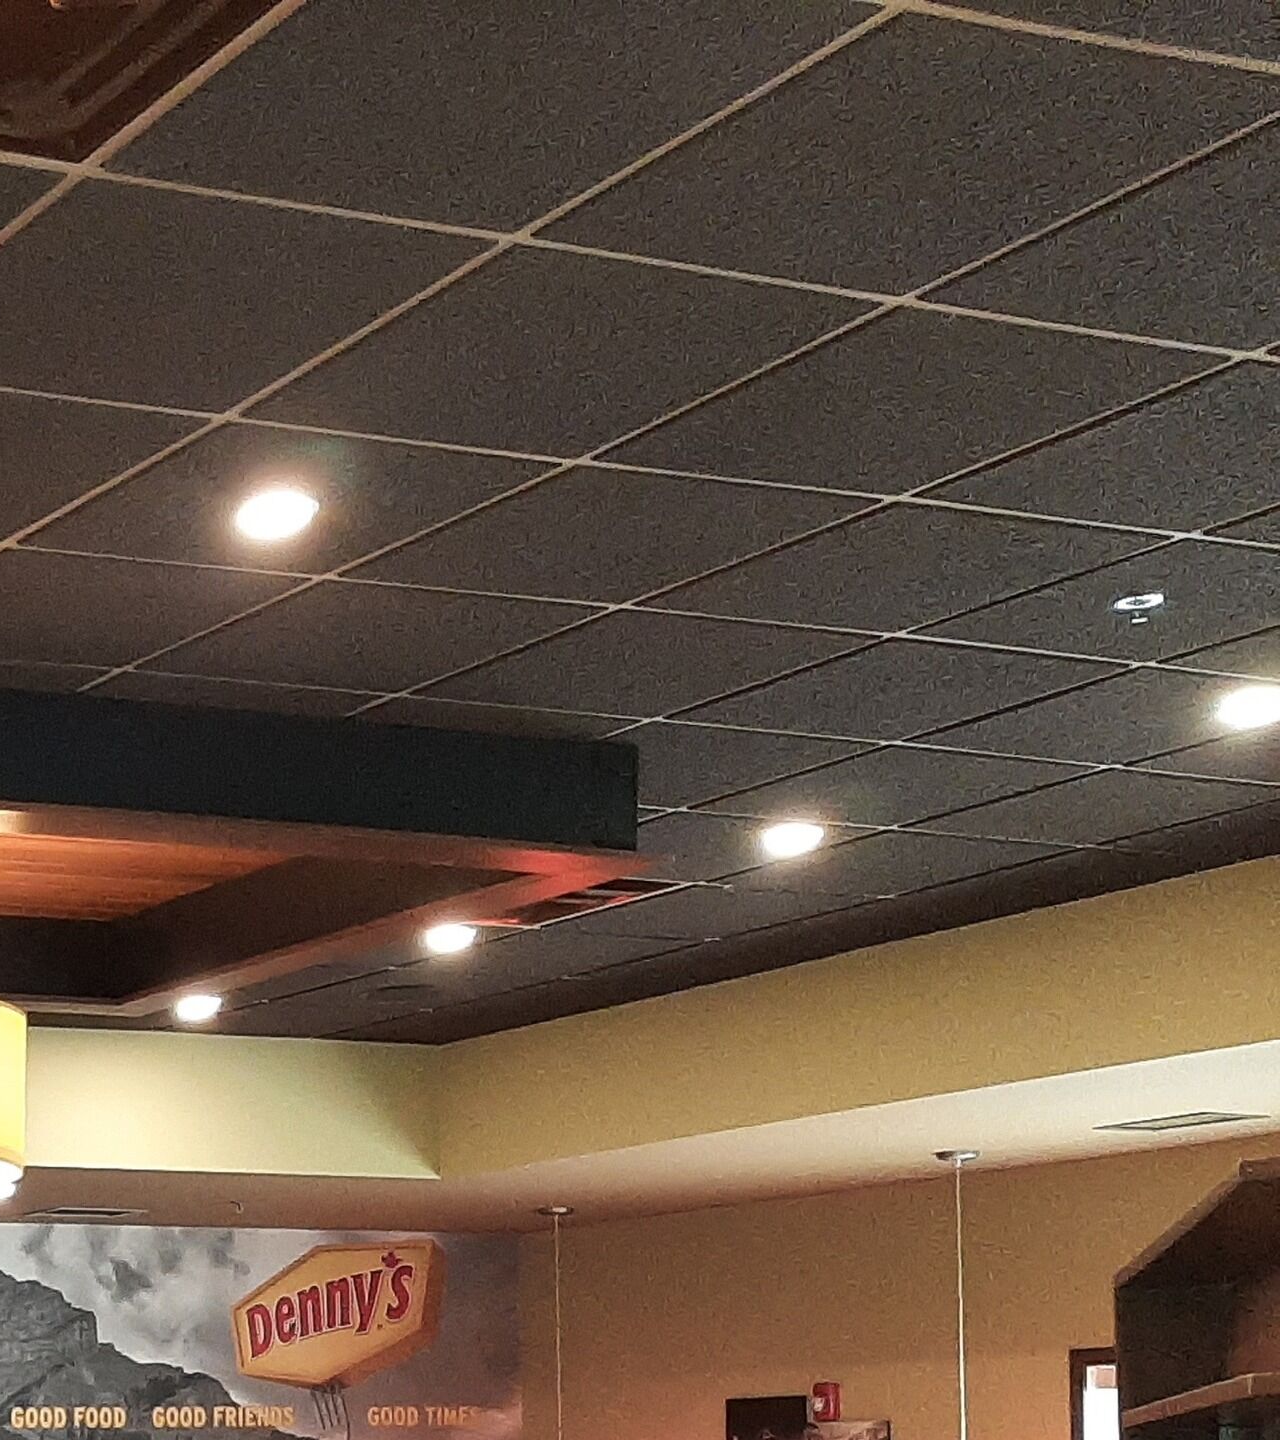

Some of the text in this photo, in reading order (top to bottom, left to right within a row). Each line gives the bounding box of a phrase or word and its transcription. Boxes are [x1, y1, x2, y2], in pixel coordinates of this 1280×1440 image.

[245, 1250, 415, 1360] Denny's
[10, 1406, 127, 1429] GOOD FOOD
[151, 1406, 295, 1429] GOOD FRIENDS
[366, 1405, 419, 1427] GOOD
